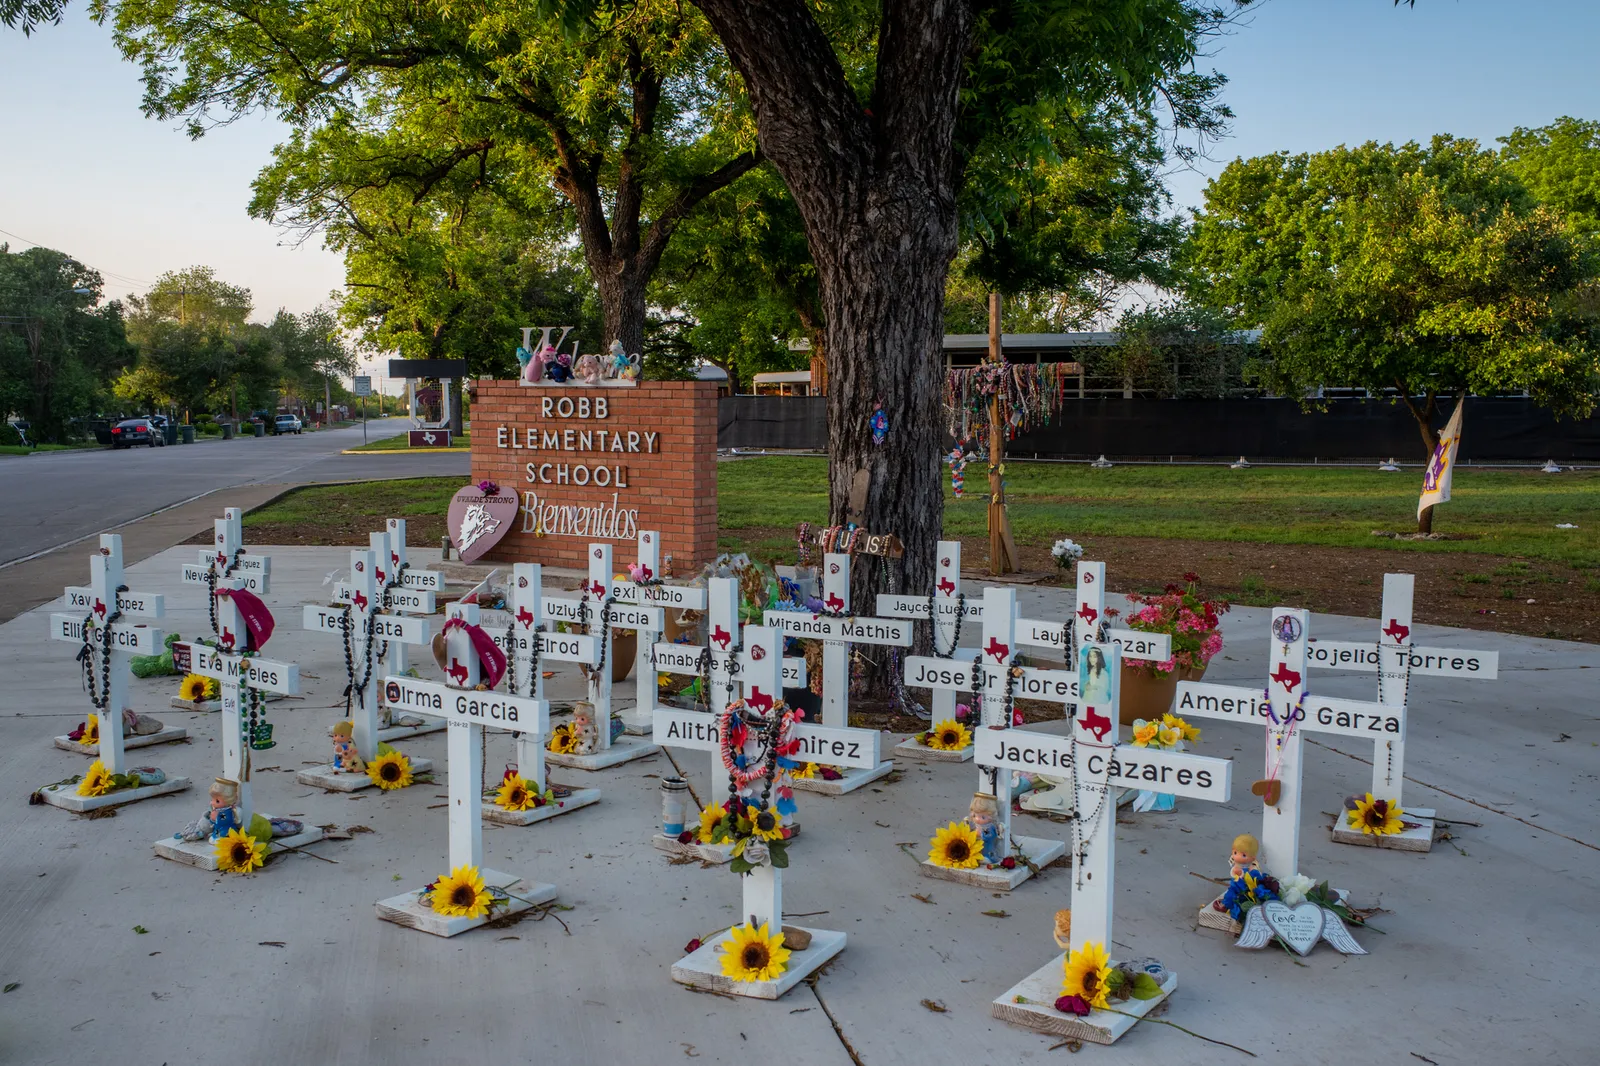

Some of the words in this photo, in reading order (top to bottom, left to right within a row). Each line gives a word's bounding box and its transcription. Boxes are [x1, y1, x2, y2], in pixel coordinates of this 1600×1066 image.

[541, 397, 609, 419] ROBB
[497, 427, 658, 453] ELEMENTARY
[525, 462, 627, 488] SCHOOL
[520, 491, 638, 540] Bienvenidos
[866, 535, 880, 553] IS
[404, 574, 436, 586] orres
[71, 593, 91, 606] Xav
[120, 600, 145, 611] opez
[375, 591, 420, 608] Siguero
[613, 586, 636, 599] exi
[645, 589, 683, 603] Rubio
[894, 601, 929, 614] Jayce
[63, 622, 80, 639] Elli
[95, 628, 138, 647] Grcia
[769, 617, 831, 634] Miranda
[842, 623, 901, 639] Mathis
[1032, 628, 1064, 645] Layl
[537, 638, 579, 655] Elrod
[200, 653, 223, 672] Eva
[228, 661, 278, 686] Meles
[650, 652, 718, 670] Annabee
[1307, 646, 1380, 667] Rojelio
[1395, 652, 1481, 671] Torres
[916, 665, 965, 685] Jose
[980, 670, 998, 688] Jr
[1013, 676, 1079, 696] lores
[402, 686, 442, 709] Irma
[456, 696, 519, 722] Garcia
[1180, 691, 1270, 718] Amerie
[1280, 702, 1306, 722] Jo
[1317, 706, 1400, 734] Garza
[667, 720, 719, 743] Alith
[994, 741, 1073, 769] Jackie
[1088, 755, 1213, 788] Cazares
